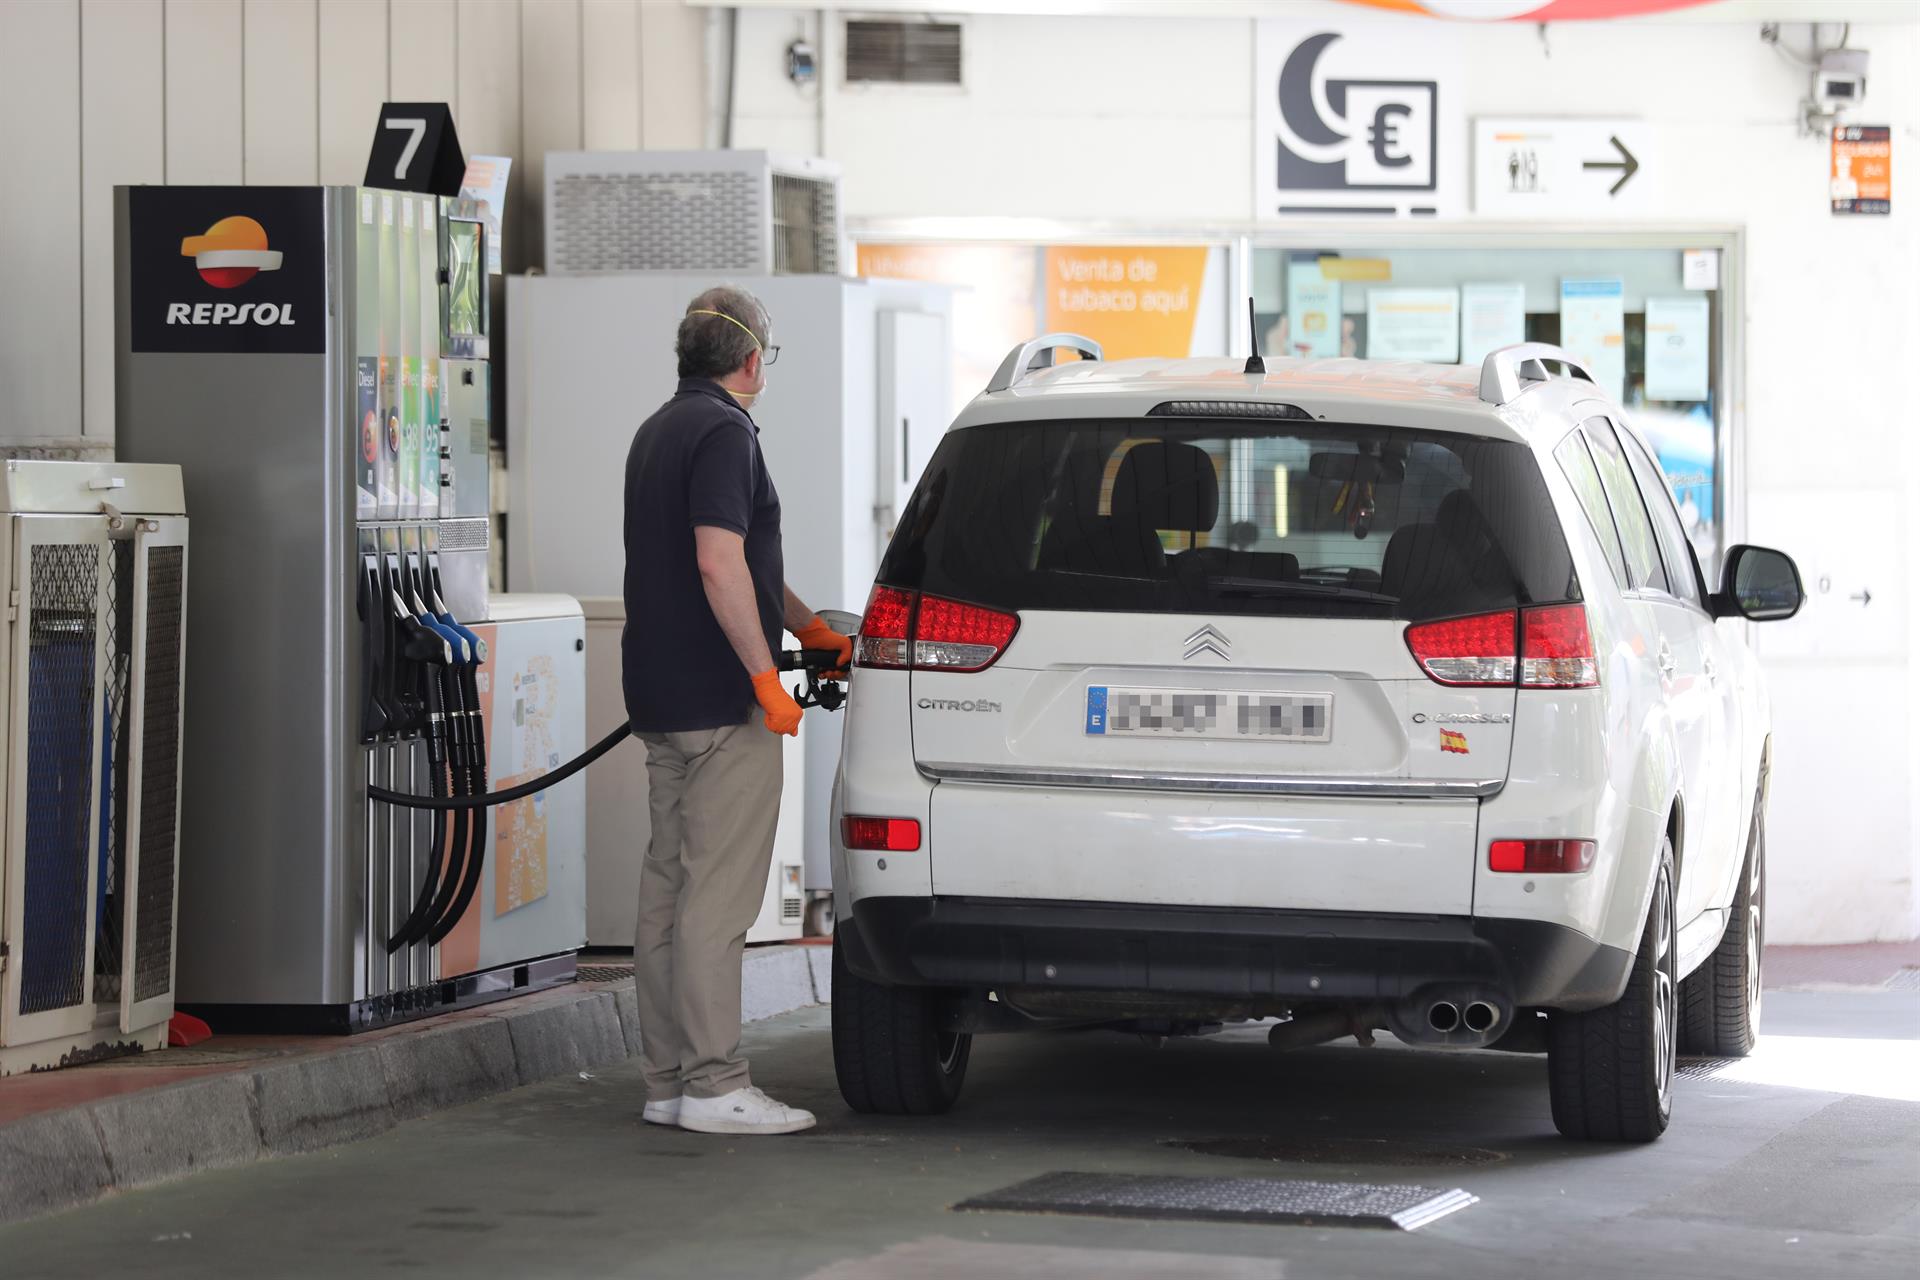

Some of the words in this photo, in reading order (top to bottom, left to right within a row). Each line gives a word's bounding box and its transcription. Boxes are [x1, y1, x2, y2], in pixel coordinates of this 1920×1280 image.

[385, 117, 427, 180] 7
[1058, 256, 1124, 282] Venta
[1128, 254, 1157, 282] de
[166, 302, 296, 326] REPSOL
[1059, 288, 1137, 312] tabaco
[1141, 283, 1188, 317] aquí
[425, 423, 439, 452] 95
[917, 698, 1002, 713] CITROËN
[1091, 714, 1101, 726] E
